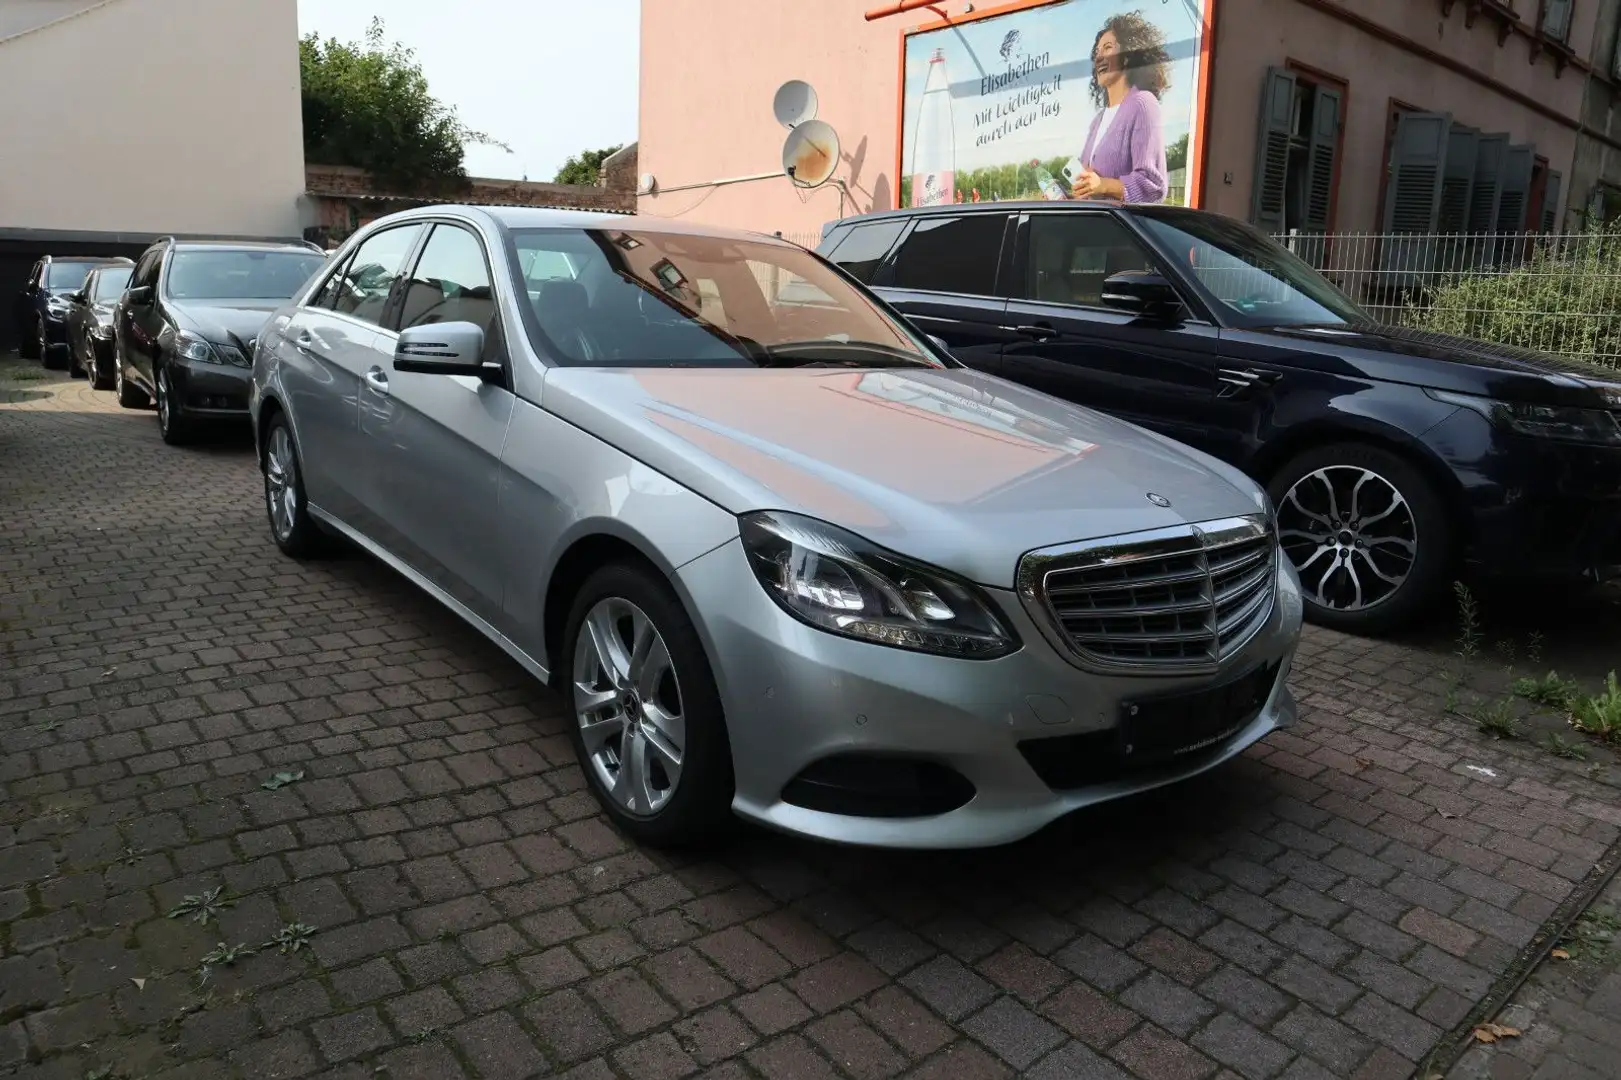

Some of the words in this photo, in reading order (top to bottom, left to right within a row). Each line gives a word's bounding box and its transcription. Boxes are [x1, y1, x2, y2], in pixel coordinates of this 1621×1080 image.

[981, 51, 1049, 96] Elisabethen
[974, 107, 992, 129] Mit
[996, 74, 1062, 118] Leichtigkeit
[976, 119, 1012, 147] durch
[1015, 111, 1037, 130] den
[1041, 99, 1061, 118] Tag
